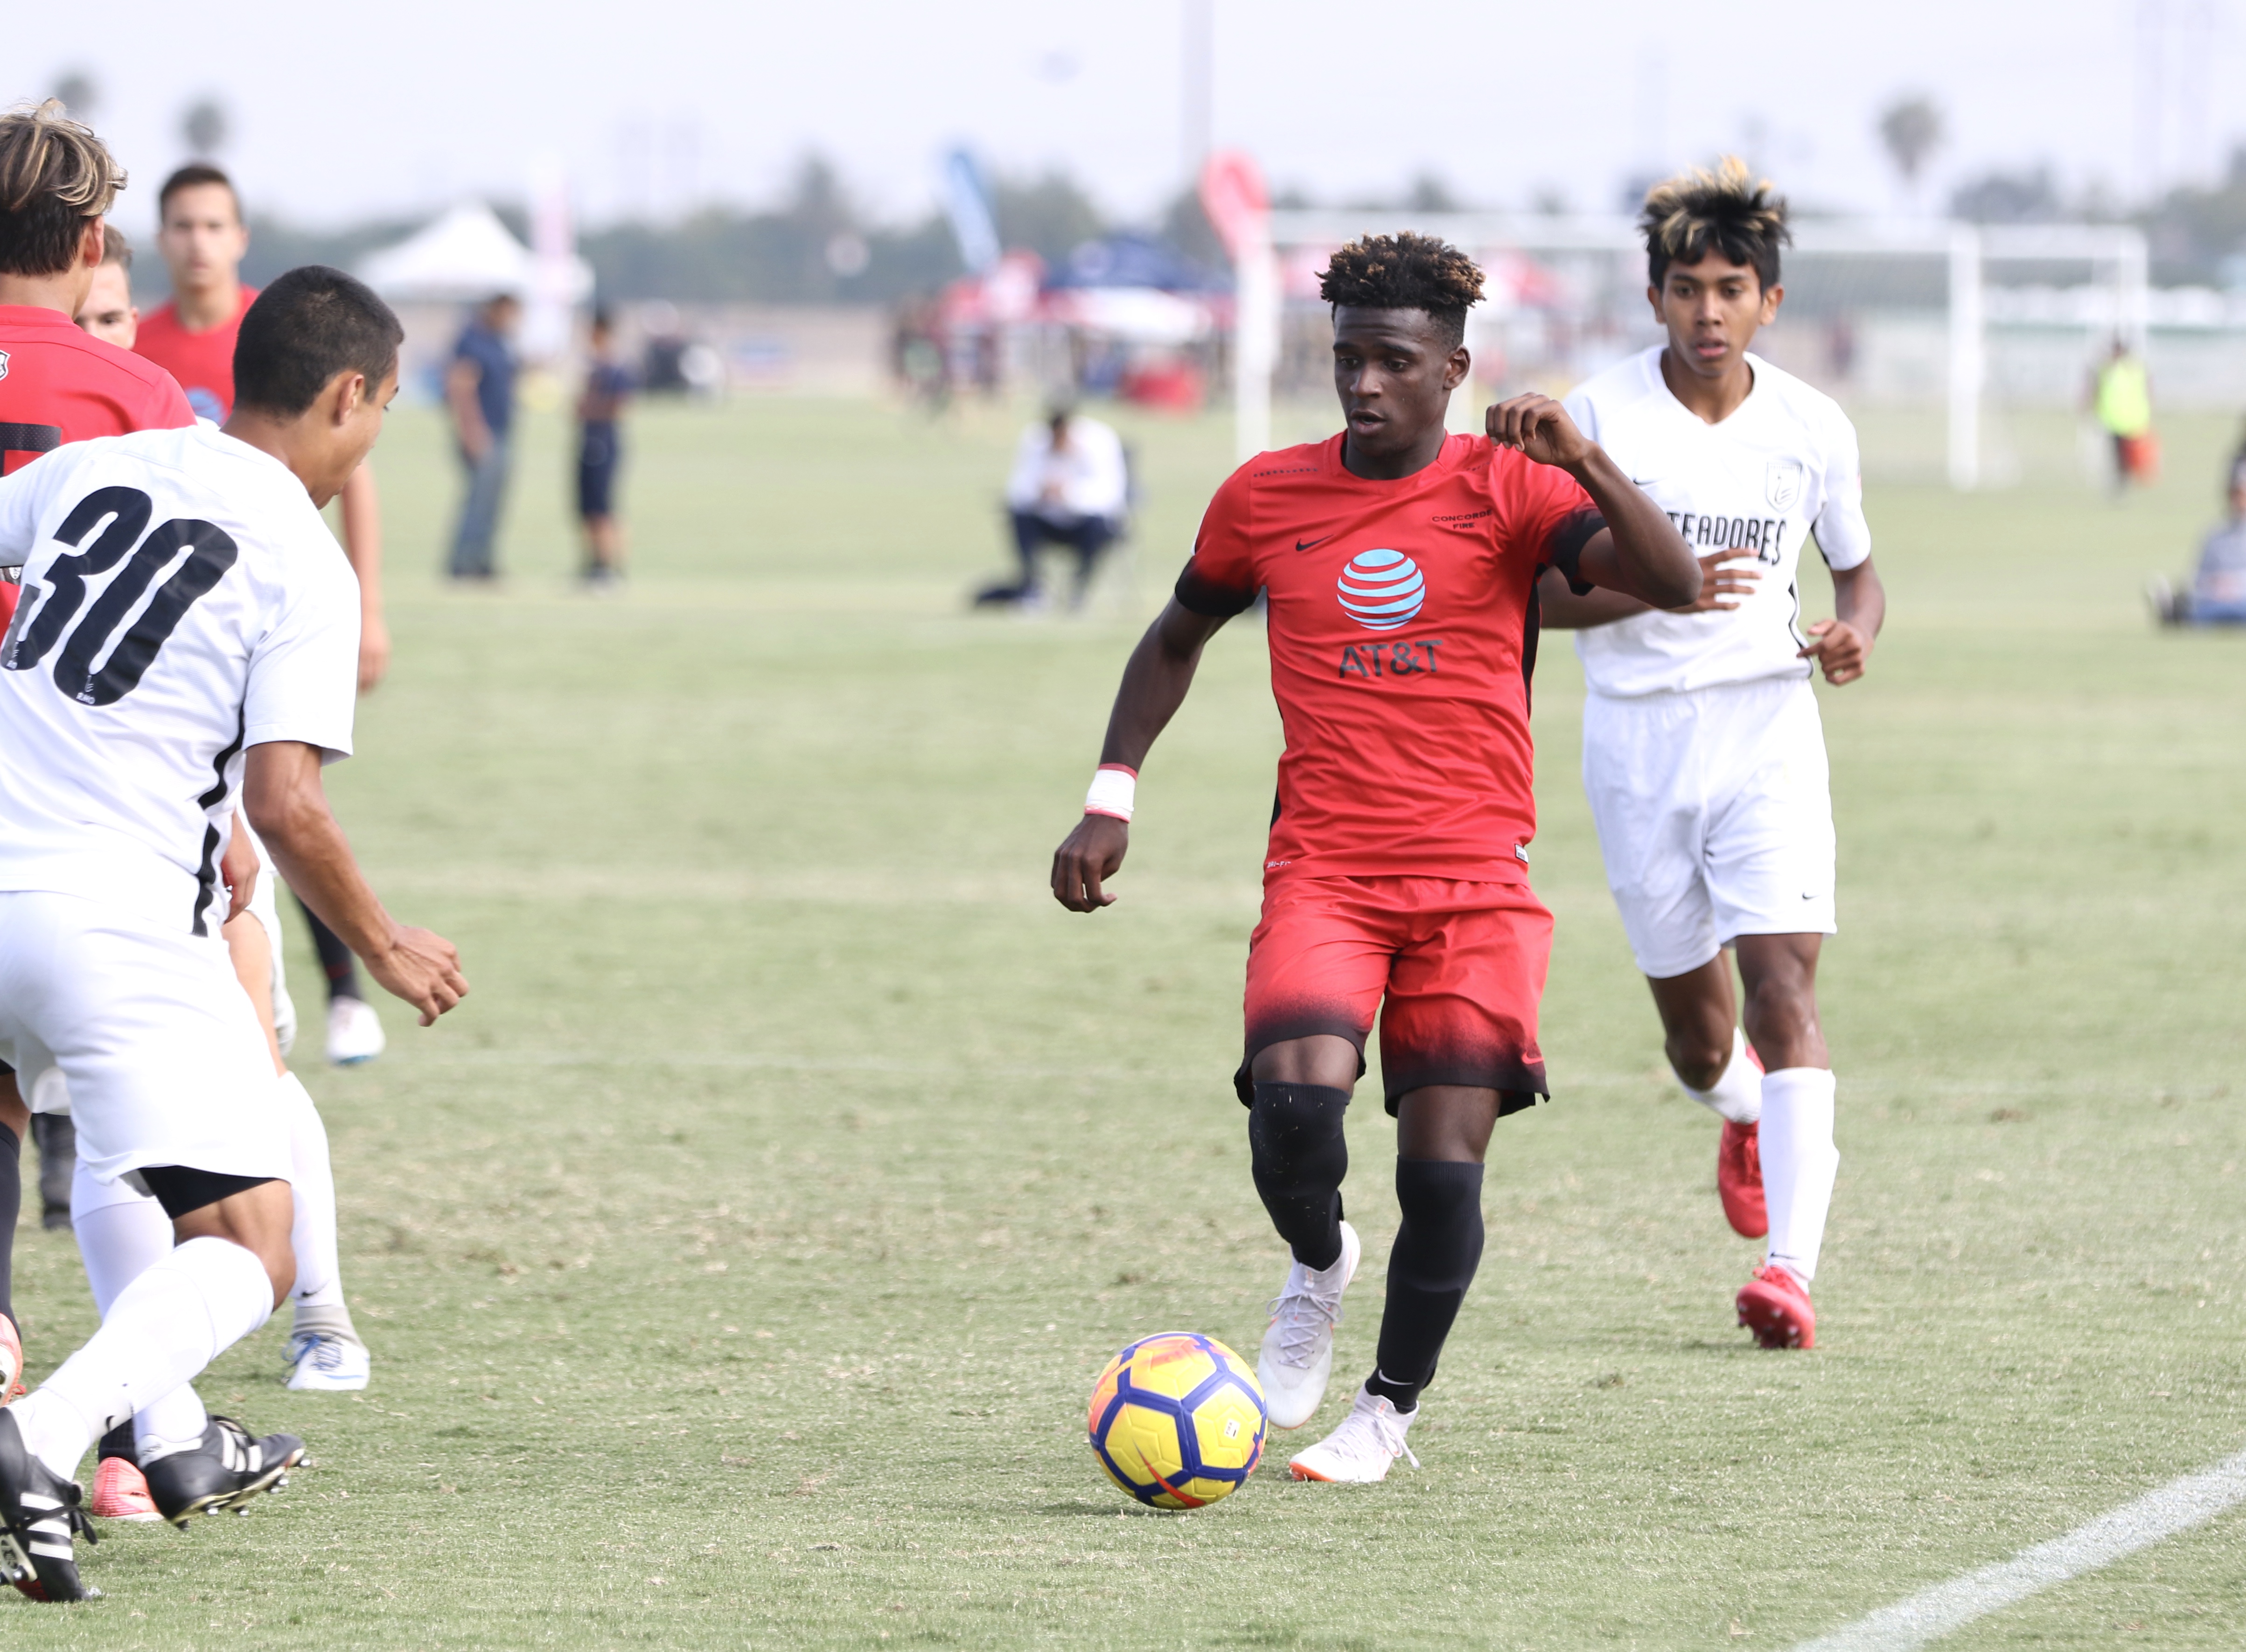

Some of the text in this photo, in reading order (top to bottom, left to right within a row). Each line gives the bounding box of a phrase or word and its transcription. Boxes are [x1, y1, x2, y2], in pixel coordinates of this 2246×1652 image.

[1432, 509, 1492, 522] CONCORDE
[0, 486, 238, 706] 30
[1339, 640, 1443, 678] AT&T
